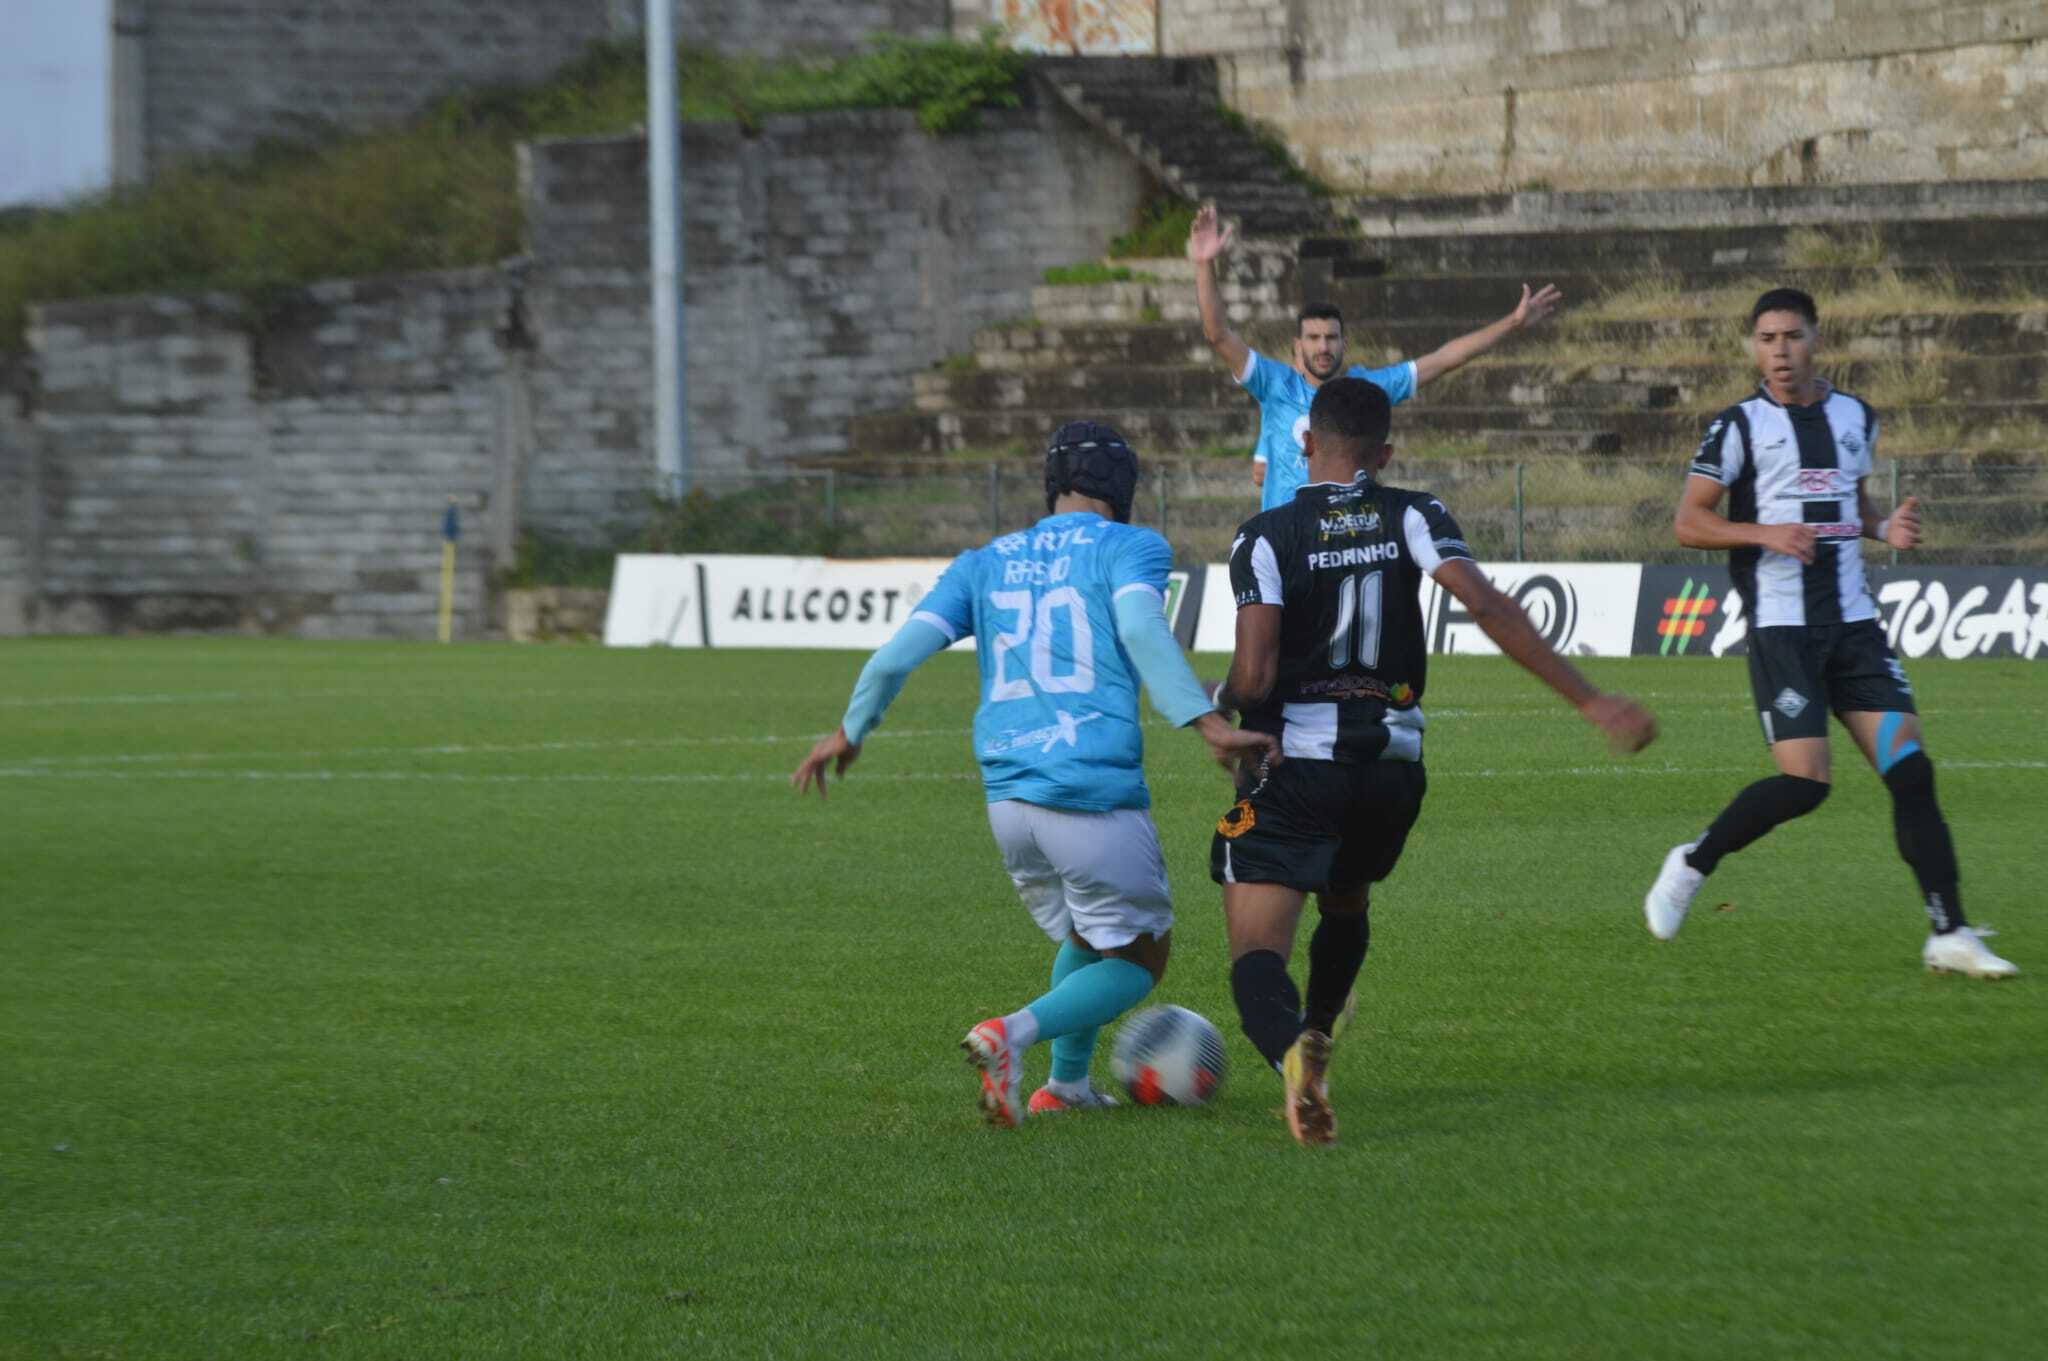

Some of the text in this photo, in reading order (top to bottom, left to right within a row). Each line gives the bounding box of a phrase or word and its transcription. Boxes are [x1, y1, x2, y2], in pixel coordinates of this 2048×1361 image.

[1308, 541, 1399, 571] PEDRINHO
[732, 587, 901, 623] ALLCOST
[1329, 570, 1384, 670] 11
[990, 586, 1095, 701] 20
